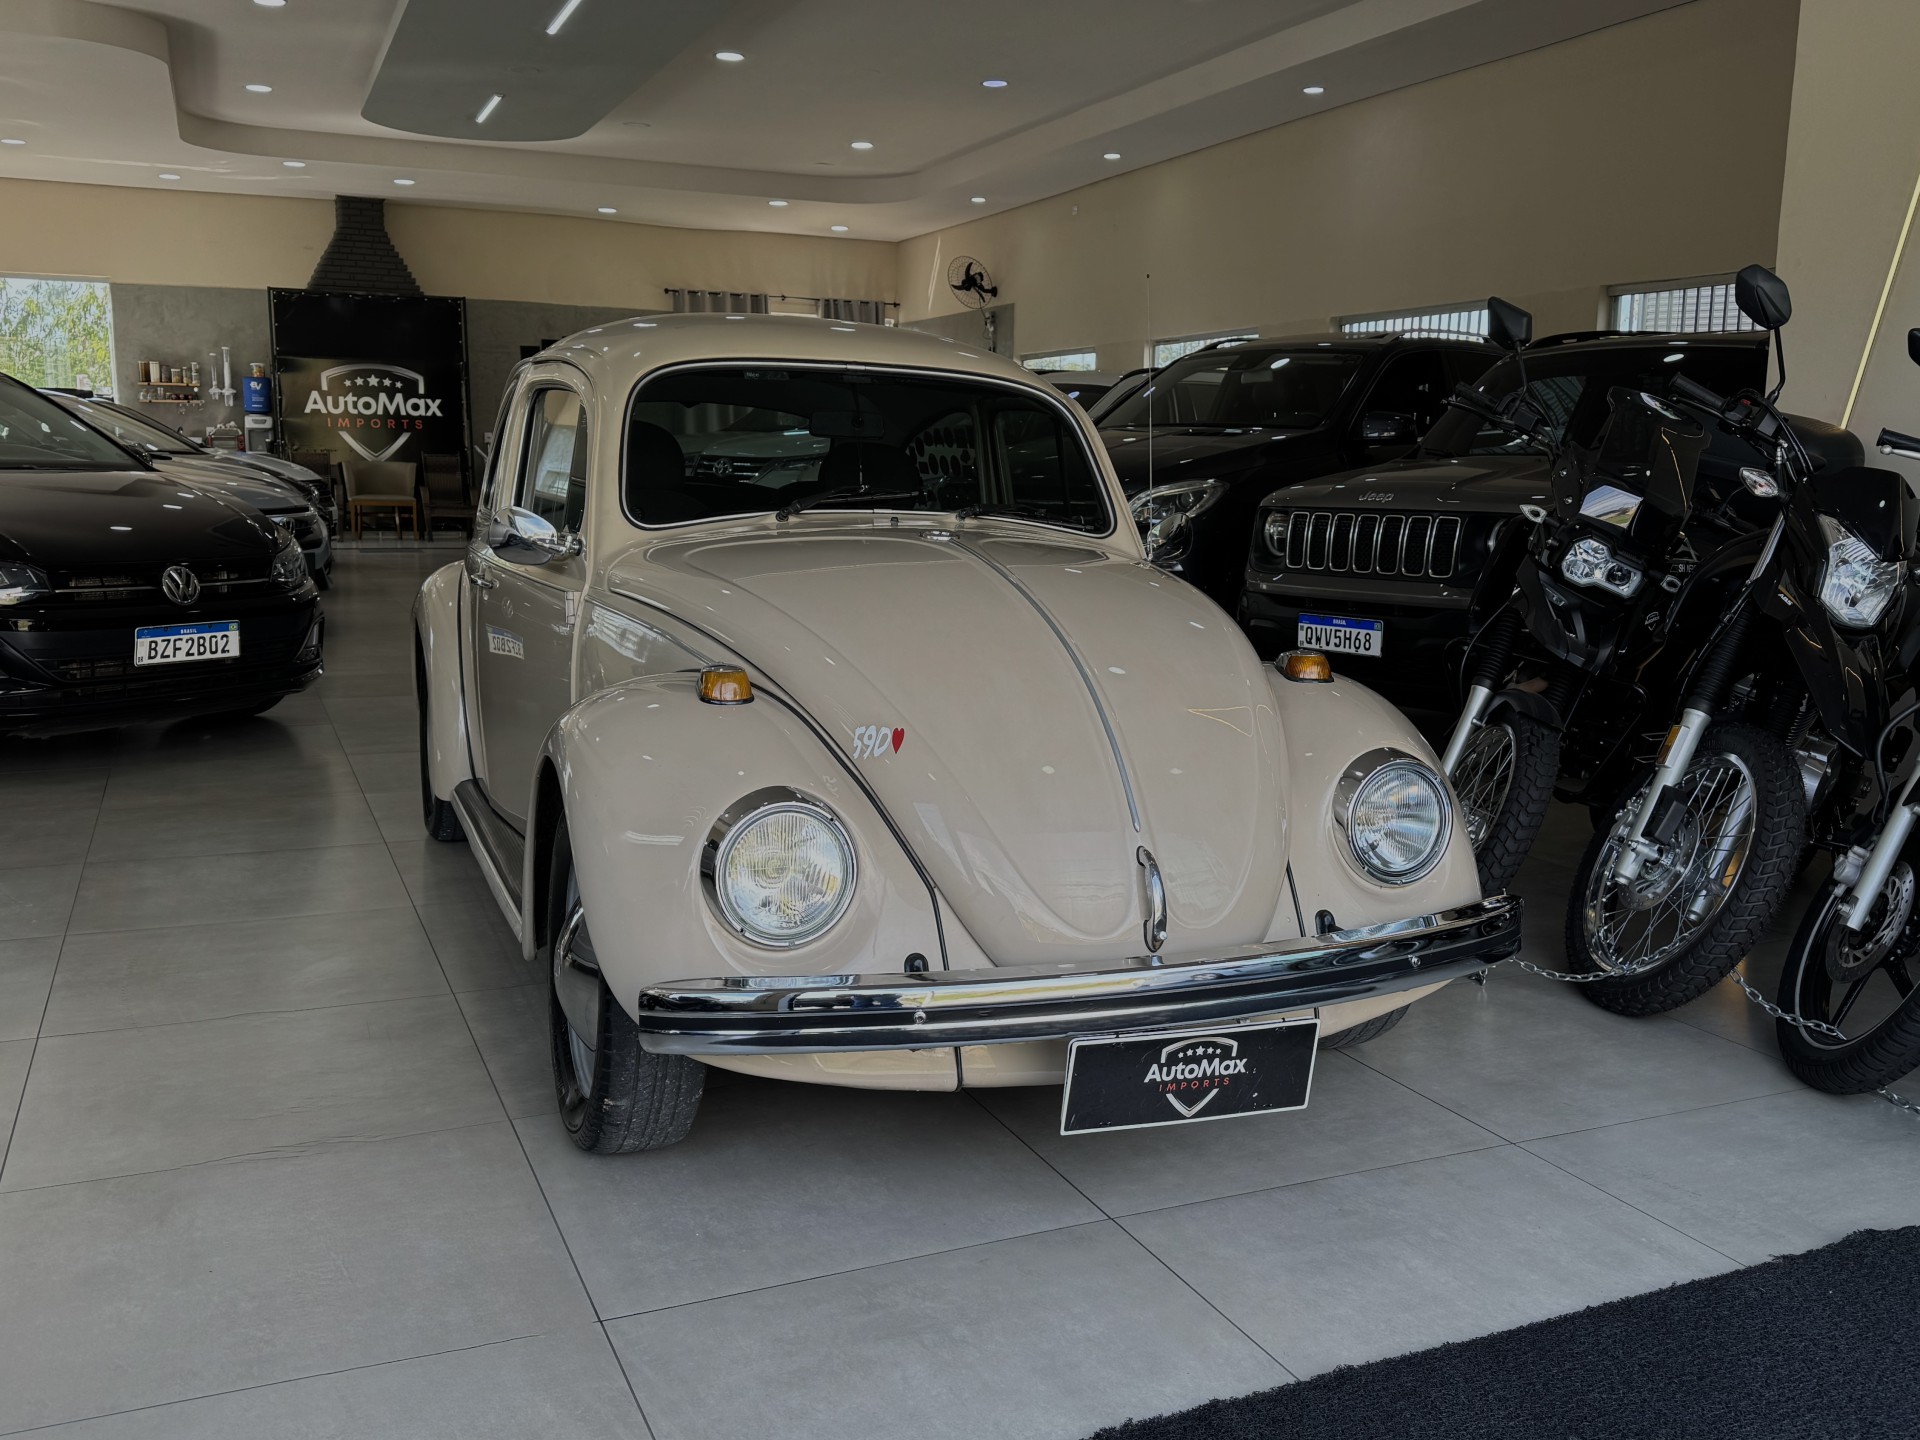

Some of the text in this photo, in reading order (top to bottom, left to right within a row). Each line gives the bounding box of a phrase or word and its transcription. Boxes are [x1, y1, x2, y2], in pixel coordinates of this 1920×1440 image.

[304, 390, 443, 417] AutoMax
[327, 417, 424, 430] IMPORTS
[1358, 490, 1395, 503] Jeep
[1332, 618, 1347, 626] BRASIL
[148, 634, 230, 660] BZF2B02
[1305, 626, 1372, 651] QWV5H68
[1143, 1056, 1248, 1083] AutoMax
[1158, 1077, 1231, 1093] IMPORTS
